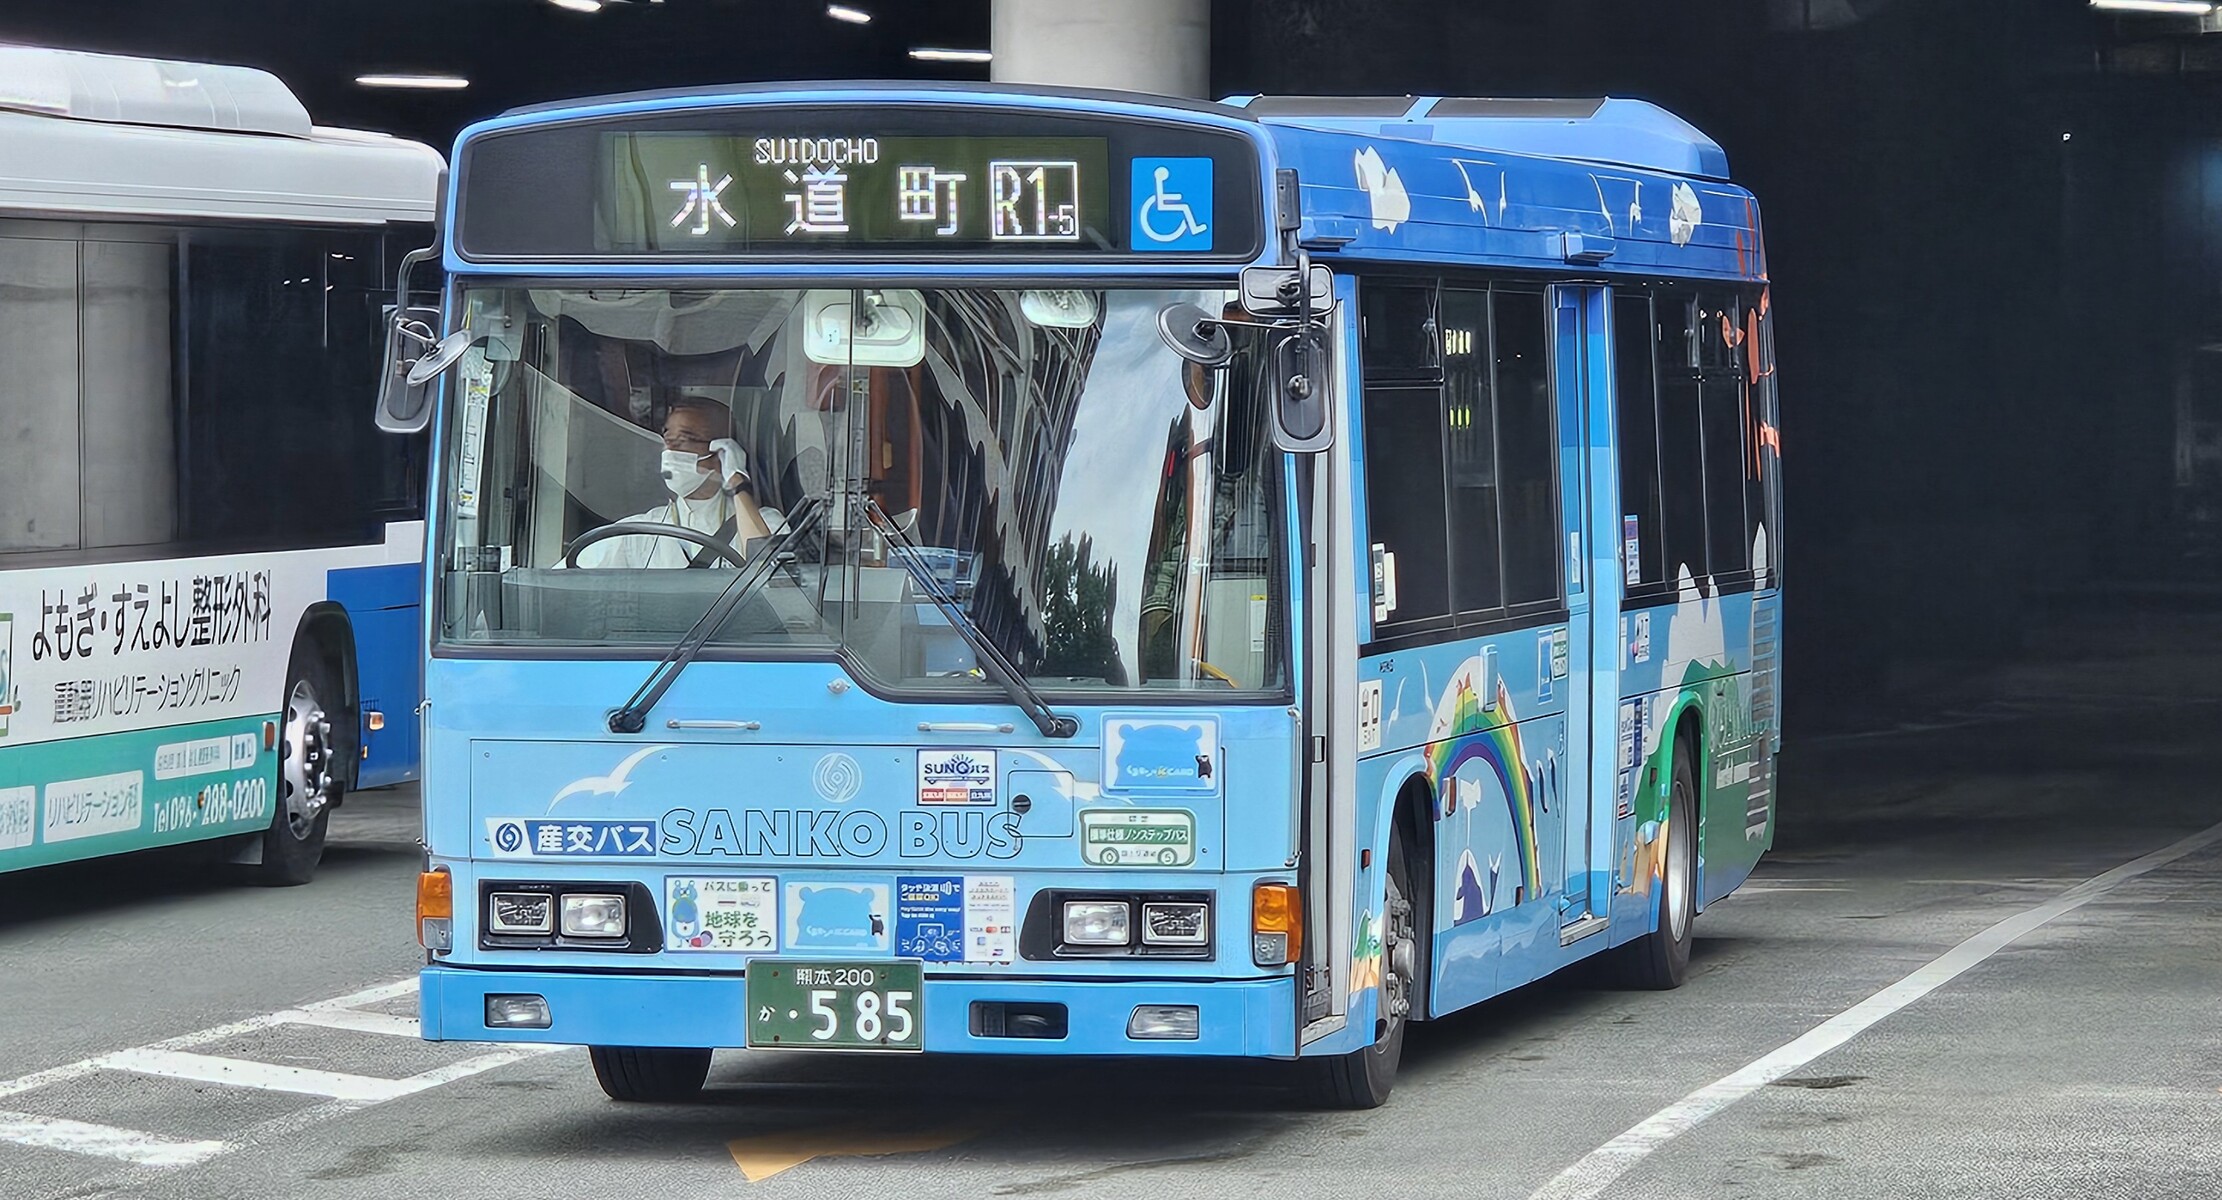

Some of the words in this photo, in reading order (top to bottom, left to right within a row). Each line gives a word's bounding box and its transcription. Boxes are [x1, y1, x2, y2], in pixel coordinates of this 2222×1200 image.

[755, 138, 878, 164] SUIDOCHO
[537, 824, 654, 853] 産交バス
[660, 808, 888, 857] SANKO
[899, 811, 1024, 859] BUS
[705, 911, 758, 928] 地球を
[718, 930, 772, 948] 守ろう
[758, 1005, 776, 1022] か
